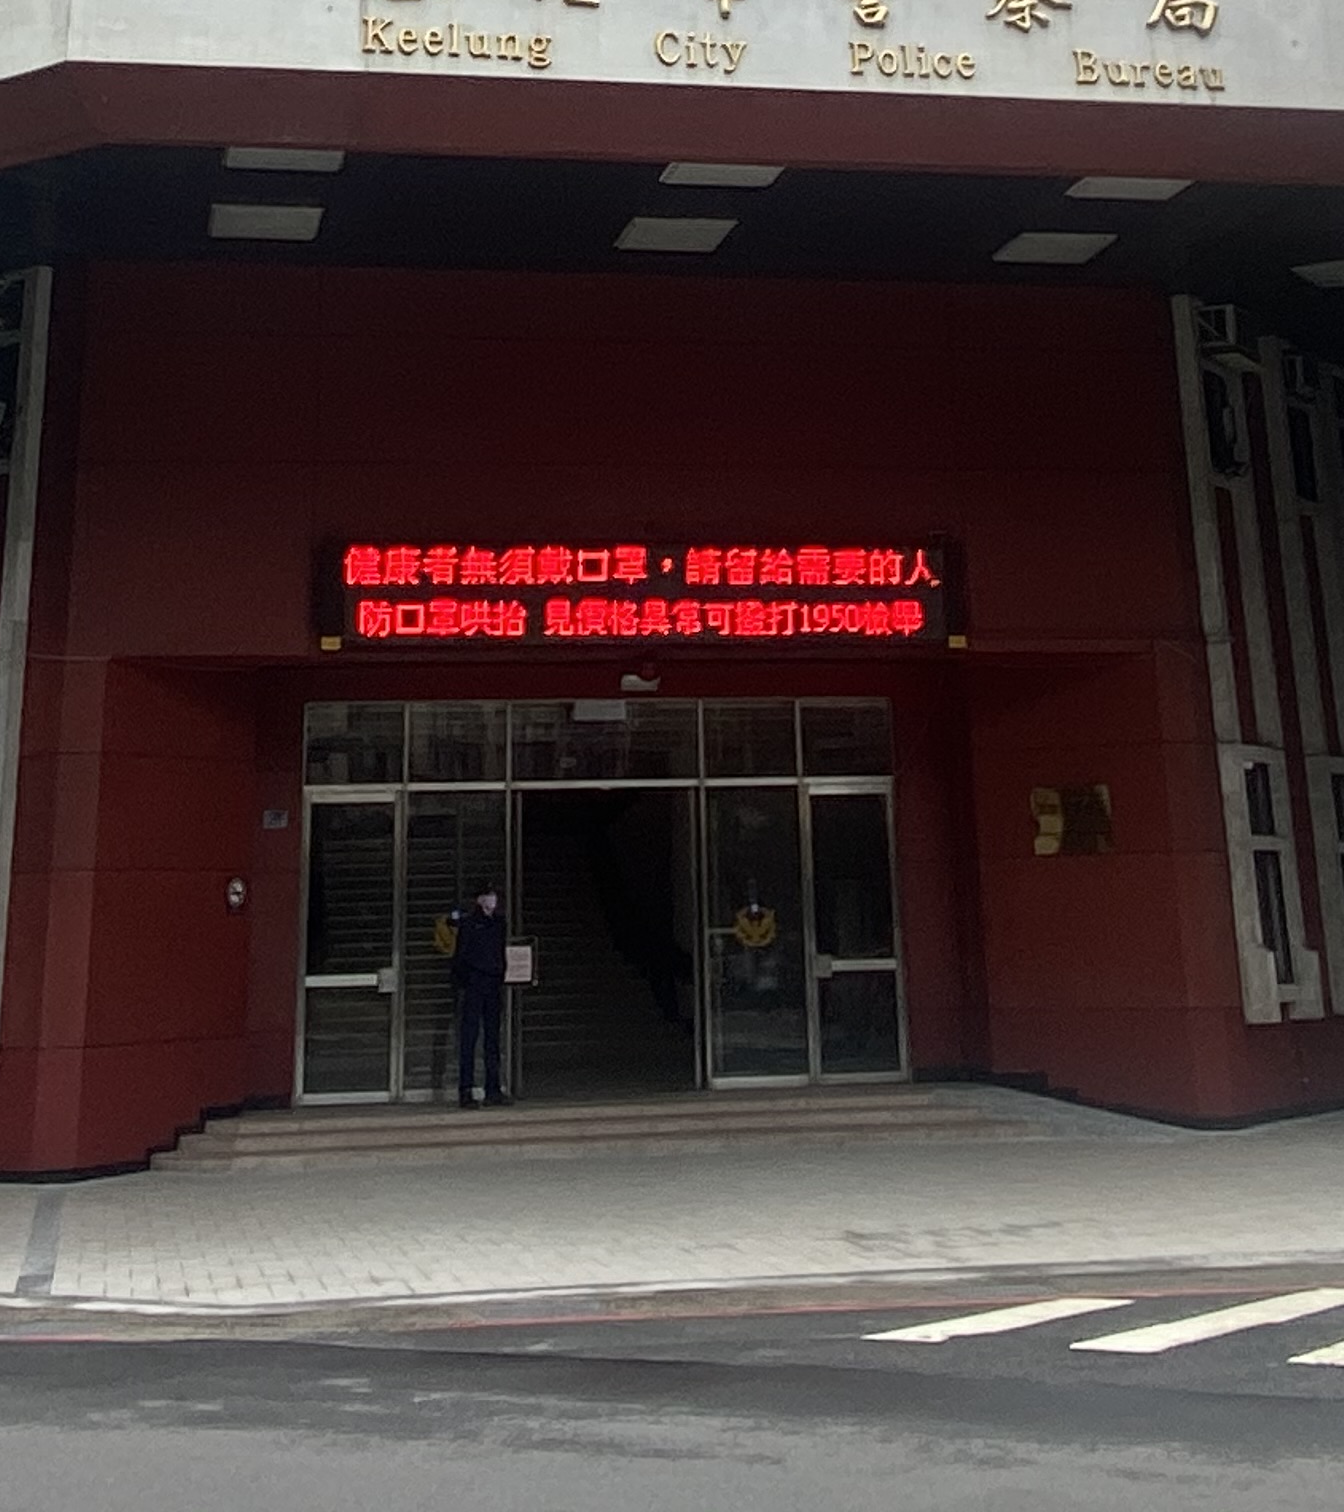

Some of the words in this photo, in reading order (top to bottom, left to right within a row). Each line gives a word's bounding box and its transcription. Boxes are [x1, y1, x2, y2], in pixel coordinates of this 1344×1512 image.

[361, 15, 552, 69] Keelung
[655, 30, 748, 74] City
[848, 41, 977, 79] Police
[1073, 49, 1226, 90] Bureau
